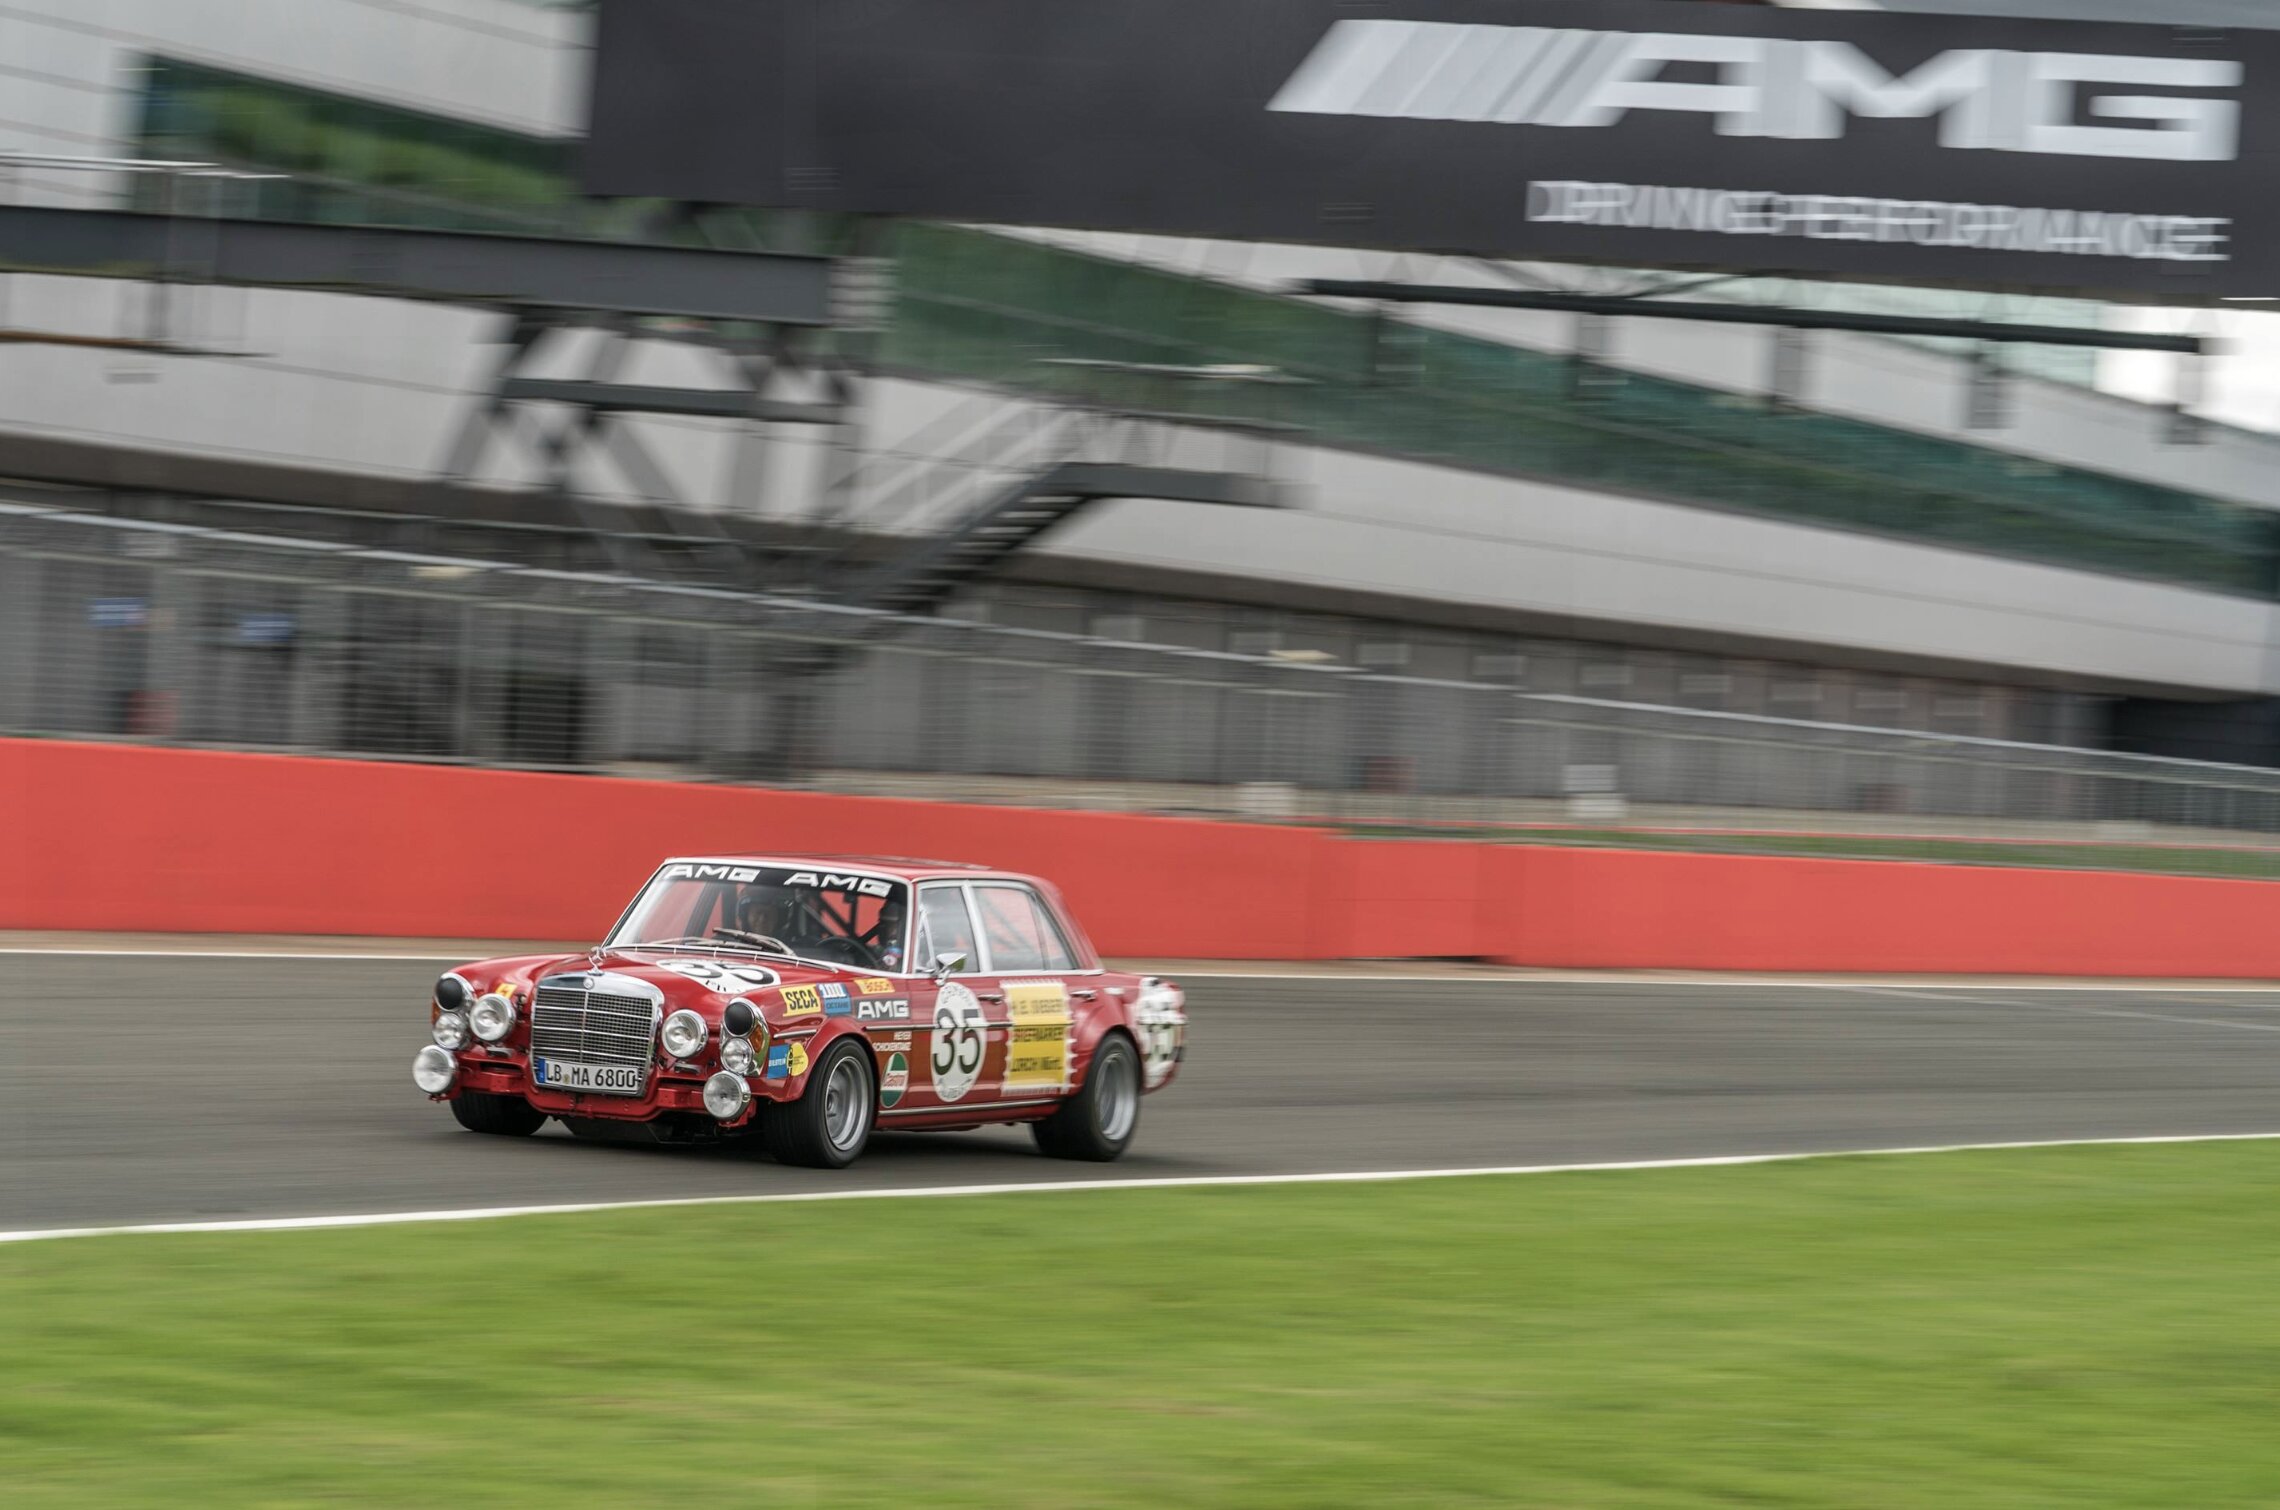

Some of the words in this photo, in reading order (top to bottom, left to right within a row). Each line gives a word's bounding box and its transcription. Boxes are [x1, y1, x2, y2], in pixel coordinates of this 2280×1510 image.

[1570, 30, 2244, 160] AMG
[664, 864, 760, 883] AMG
[783, 872, 893, 898] AMG
[660, 961, 774, 985] 35
[785, 990, 818, 1010] SECA
[819, 983, 847, 998] 100
[858, 1000, 909, 1018] AMG
[933, 1008, 981, 1075] 35
[546, 1062, 562, 1082] LB
[571, 1067, 590, 1086] MA
[594, 1069, 636, 1088] 6800
